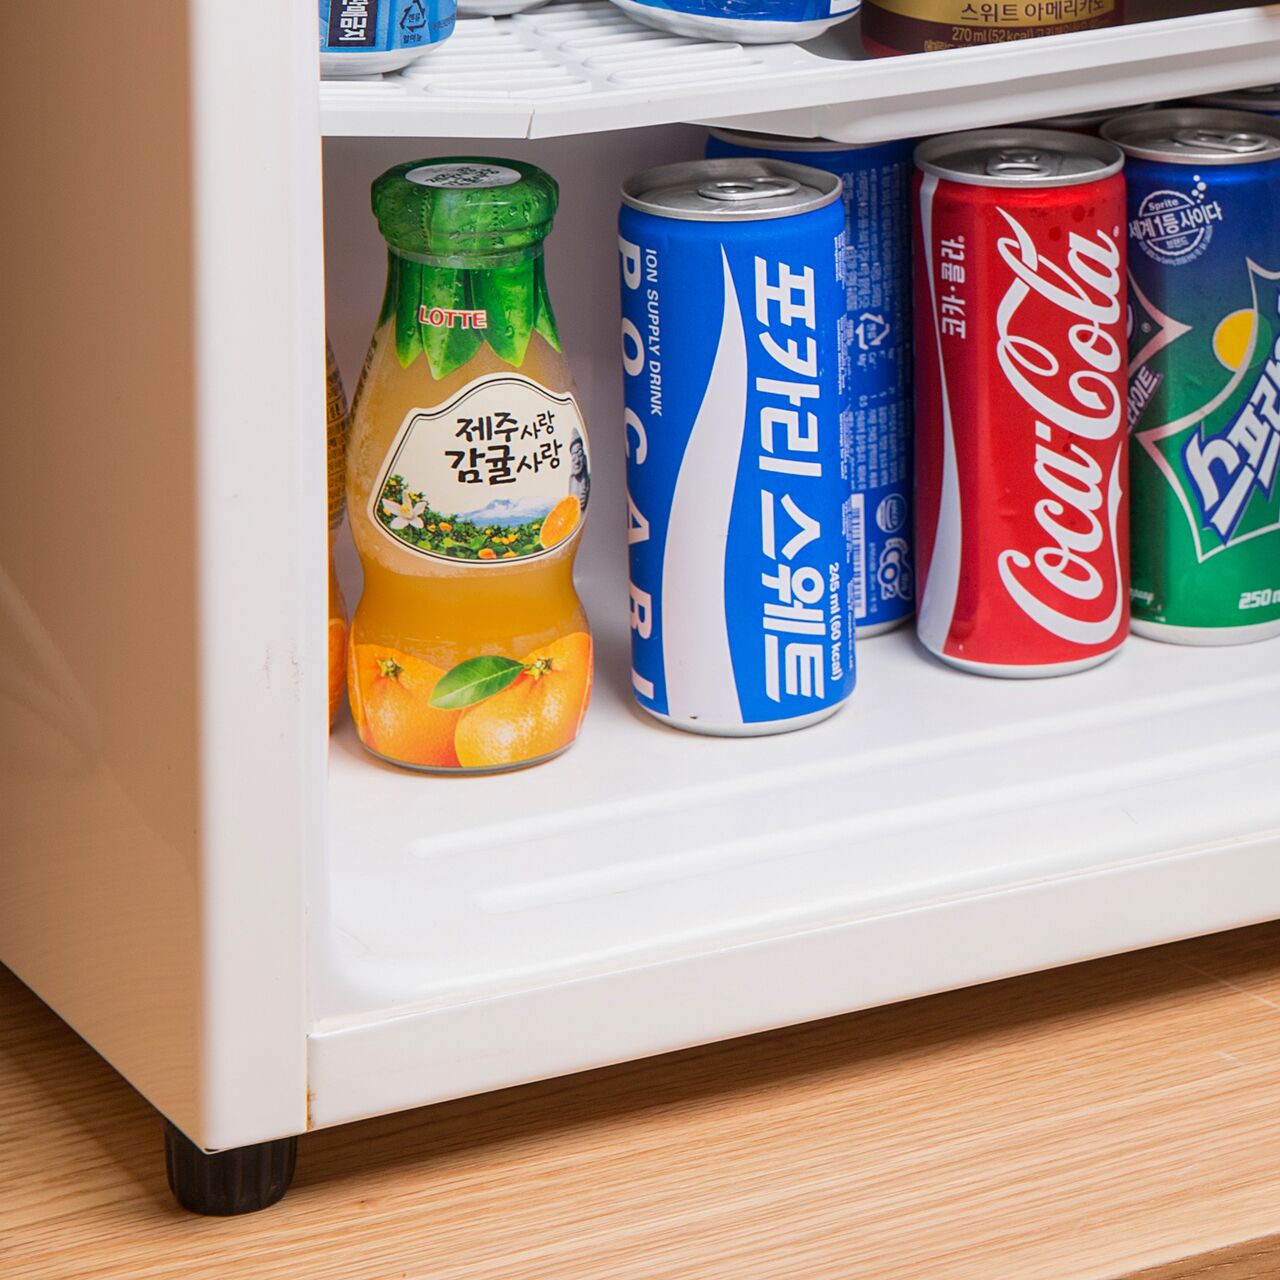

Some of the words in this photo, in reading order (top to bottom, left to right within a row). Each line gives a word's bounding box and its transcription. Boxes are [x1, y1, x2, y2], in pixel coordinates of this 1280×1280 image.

[961, 3, 1019, 22] 스위트
[1148, 199, 1179, 211] Sprite
[1181, 201, 1222, 227] 사이다
[646, 249, 658, 282] ION
[419, 305, 487, 329] LOTTE
[645, 289, 660, 355] SUPPLY
[755, 256, 822, 476] 포카리
[649, 361, 663, 415] DRINK
[618, 236, 654, 700] POCARI
[828, 562, 840, 590] 245
[762, 490, 826, 702] 스웨트
[1238, 589, 1272, 610] 250
